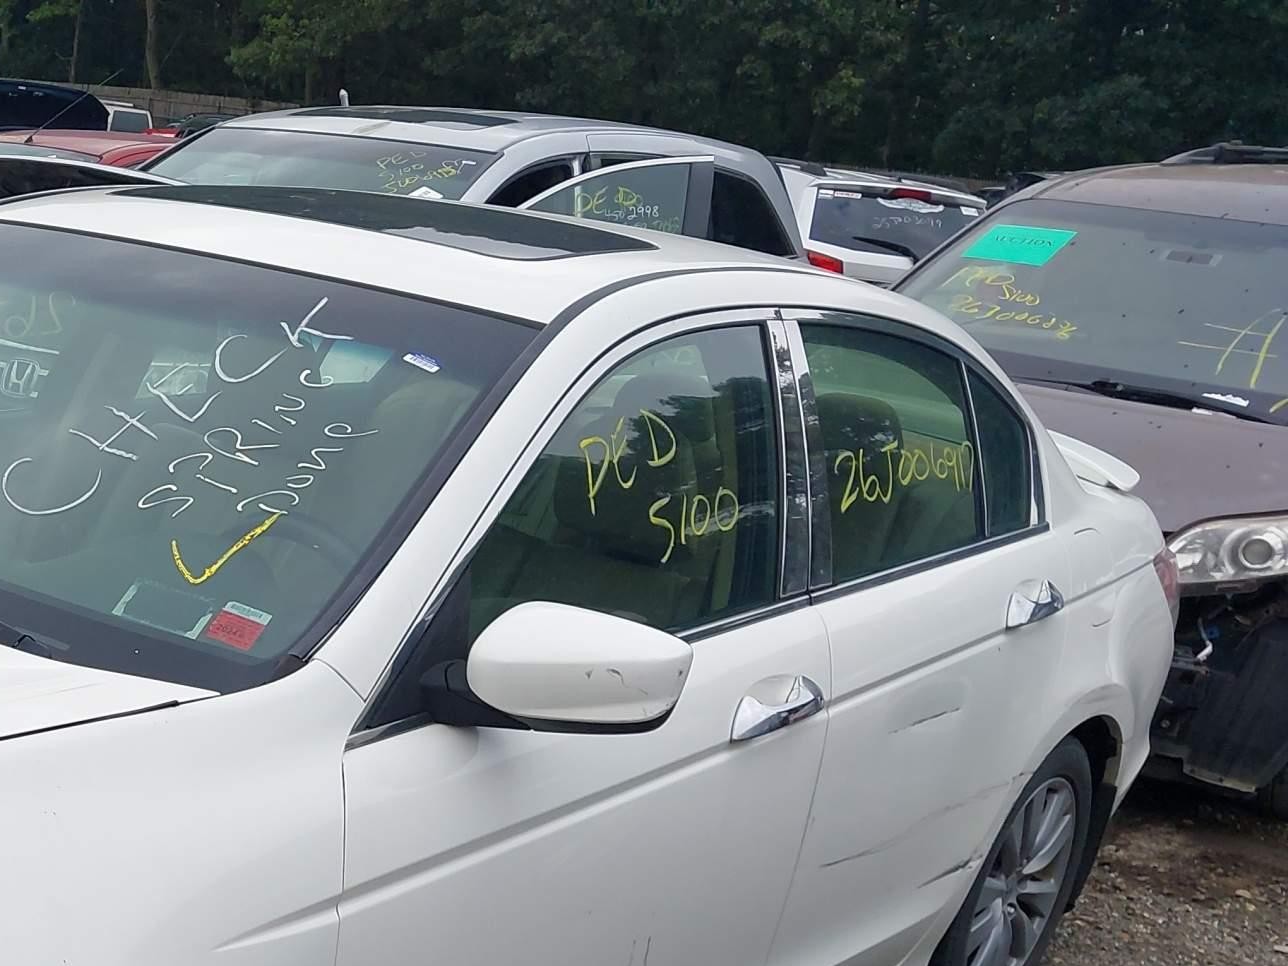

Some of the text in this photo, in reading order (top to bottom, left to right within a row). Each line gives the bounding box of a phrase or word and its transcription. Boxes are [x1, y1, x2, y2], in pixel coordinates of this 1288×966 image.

[1, 296, 355, 516] CHECK
[579, 408, 677, 517] PED
[648, 486, 740, 564] S100
